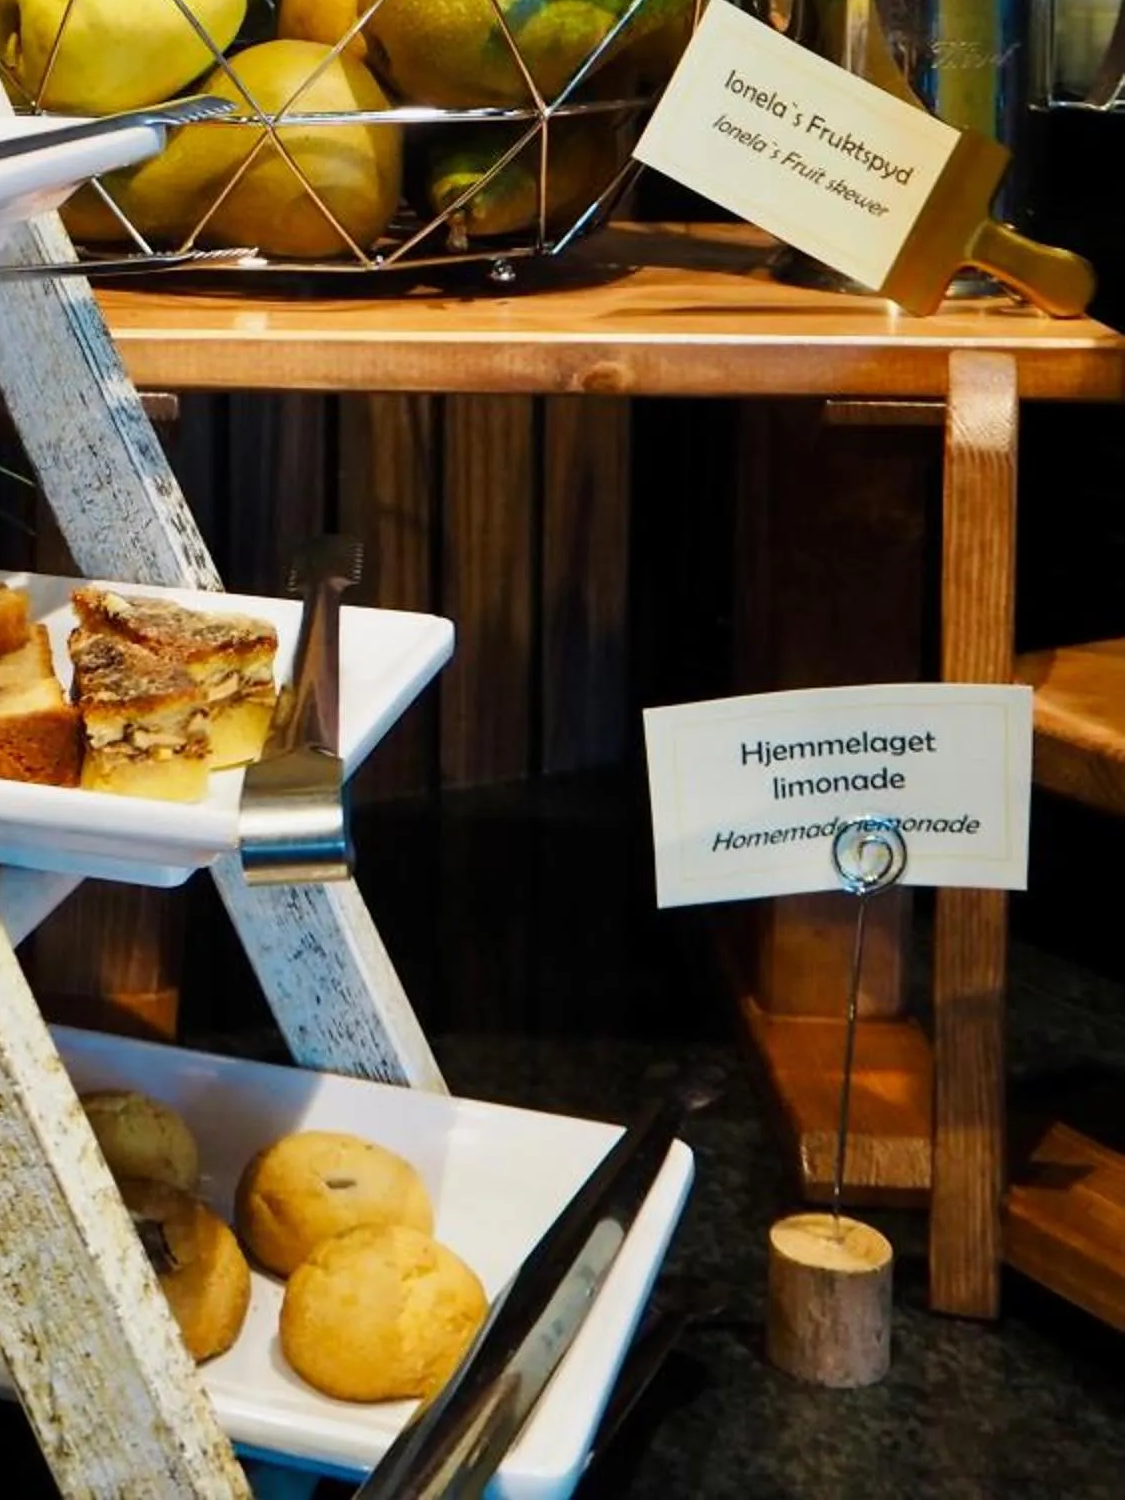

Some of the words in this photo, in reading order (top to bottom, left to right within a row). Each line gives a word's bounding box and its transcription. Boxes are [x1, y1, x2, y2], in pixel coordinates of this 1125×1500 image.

[805, 114, 915, 186] Fruktspyd
[780, 151, 826, 185] Fruit
[825, 178, 890, 217] skewer
[740, 732, 936, 766] Hjemmelaget
[773, 768, 906, 800] limonade
